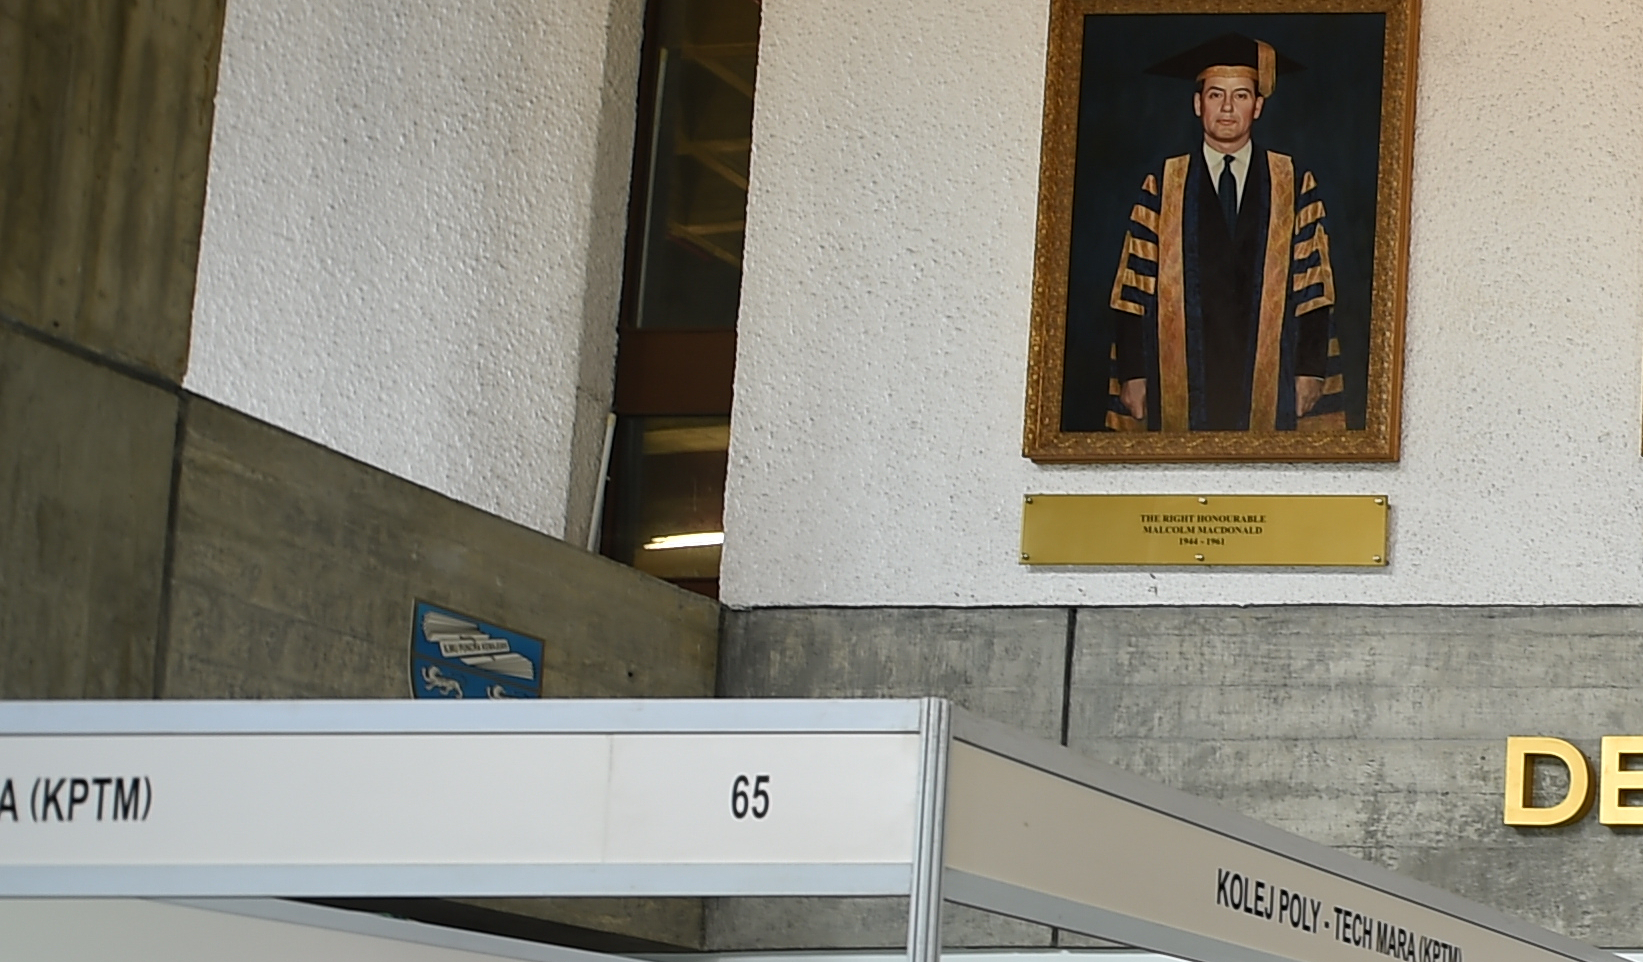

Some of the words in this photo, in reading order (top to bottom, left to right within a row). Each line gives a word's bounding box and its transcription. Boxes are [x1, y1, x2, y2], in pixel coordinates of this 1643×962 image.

[1140, 514, 1160, 523] THE
[1163, 514, 1195, 523] RIGHT
[1196, 514, 1267, 523] HONOURABLE
[1143, 525, 1195, 534] MALCOLM
[1197, 526, 1263, 535] MACDONALD
[31, 776, 152, 823] (KPTM)
[731, 774, 771, 820] 65
[1217, 868, 1275, 920] KOLEJ
[1279, 889, 1322, 933] POLY
[1333, 906, 1373, 950] TECH
